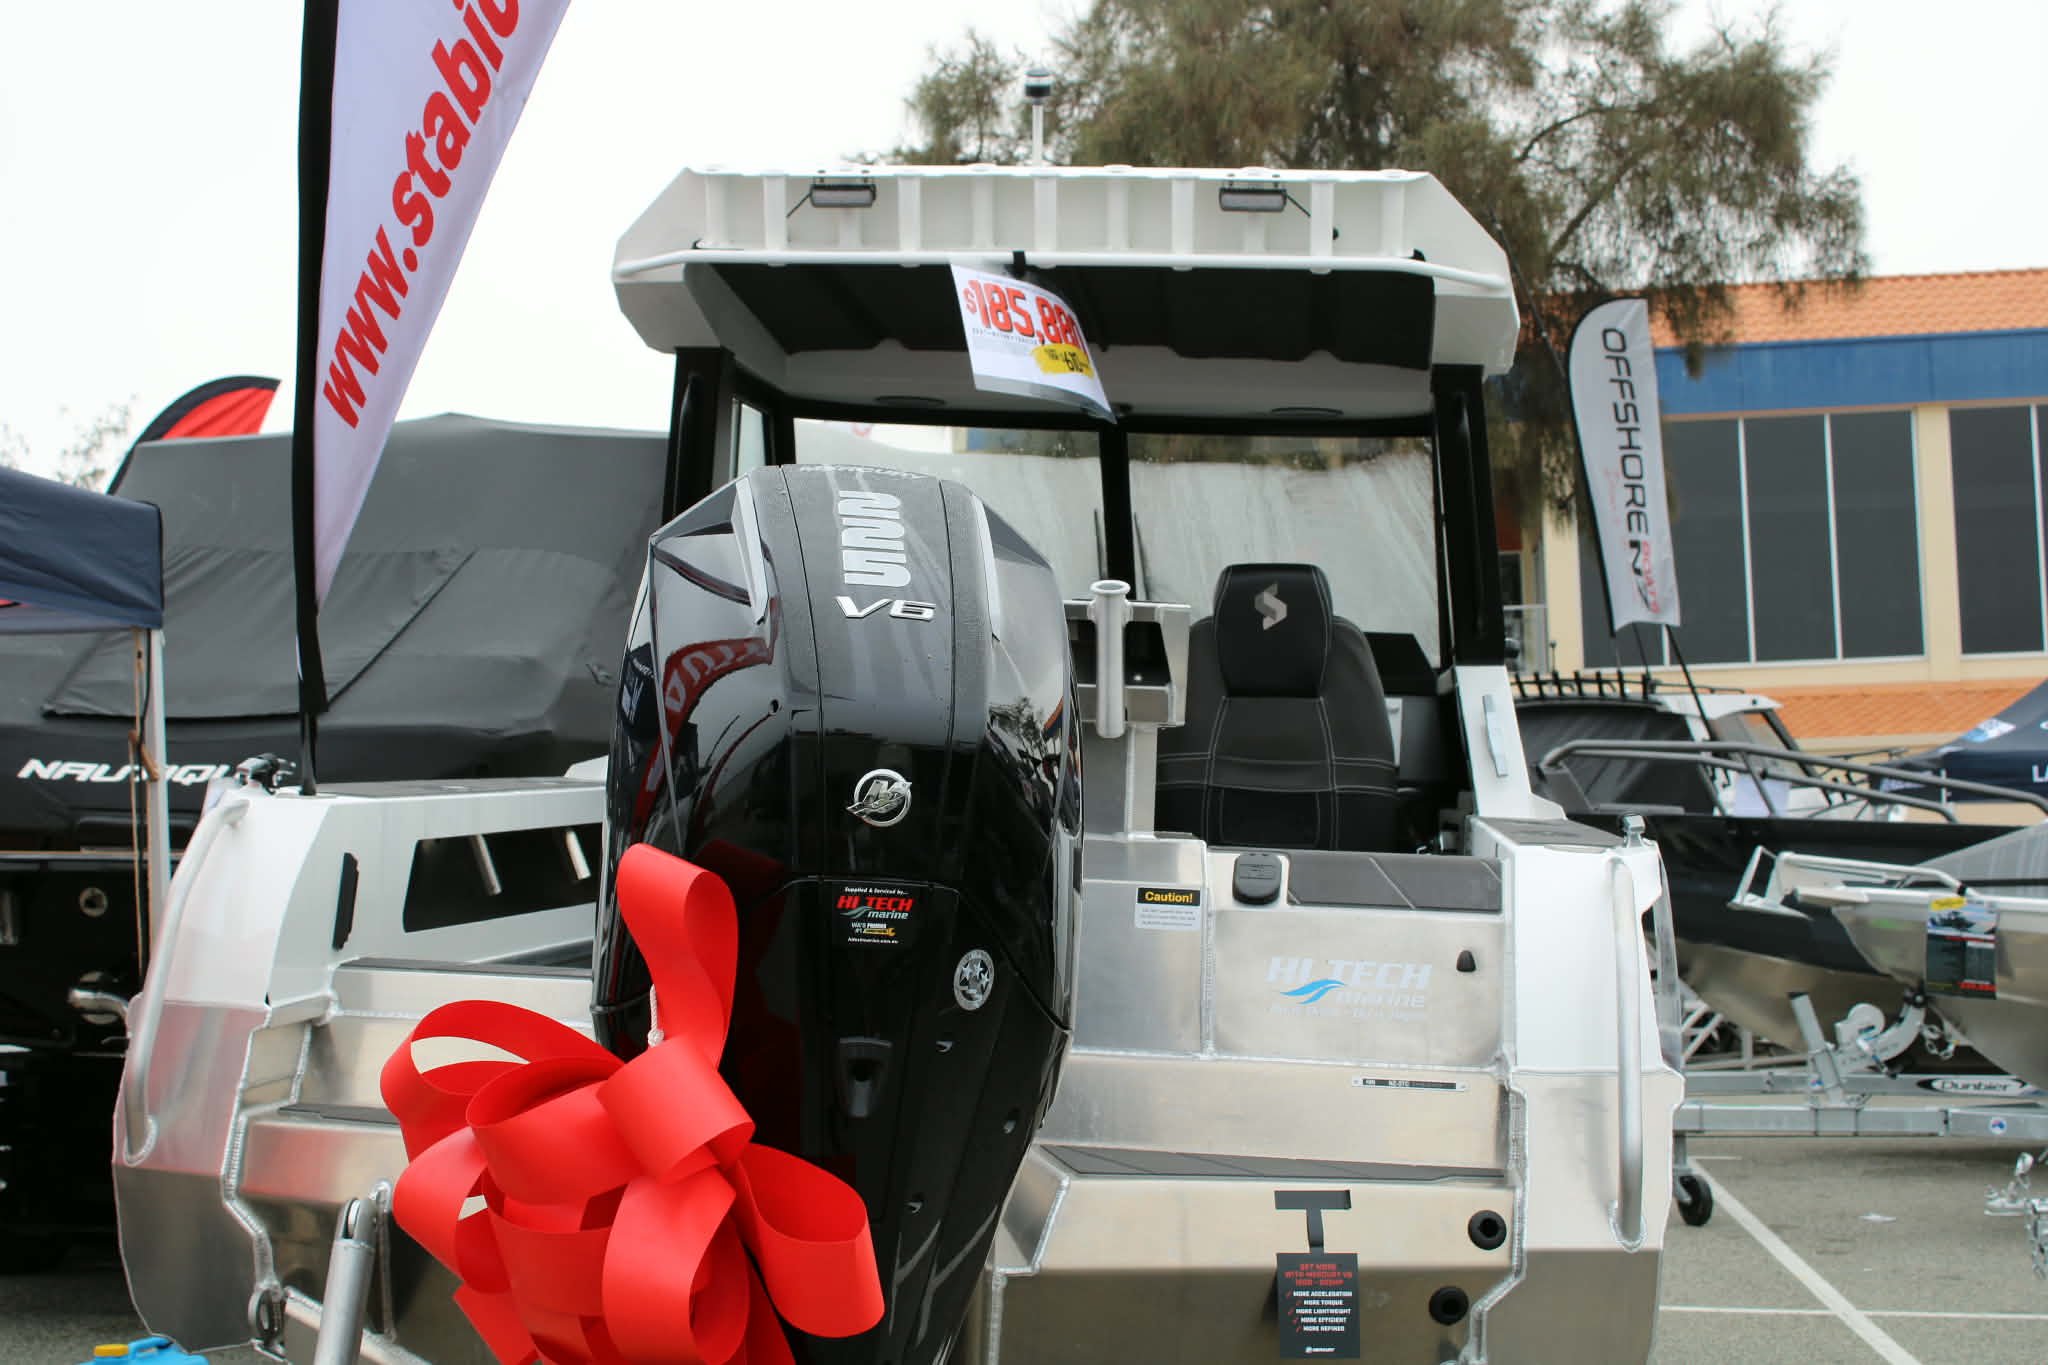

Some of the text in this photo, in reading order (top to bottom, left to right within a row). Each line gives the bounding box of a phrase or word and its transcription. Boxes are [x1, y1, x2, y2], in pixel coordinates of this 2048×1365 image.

[1602, 328, 1648, 534] OFFSHORE
[838, 490, 911, 587] 225
[835, 596, 937, 622] V6
[837, 895, 914, 912] HI TECH
[1144, 890, 1193, 904] Caution!
[867, 910, 909, 920] marine
[1327, 959, 1433, 991] TECH
[1941, 1079, 2010, 1092] Dunbier
